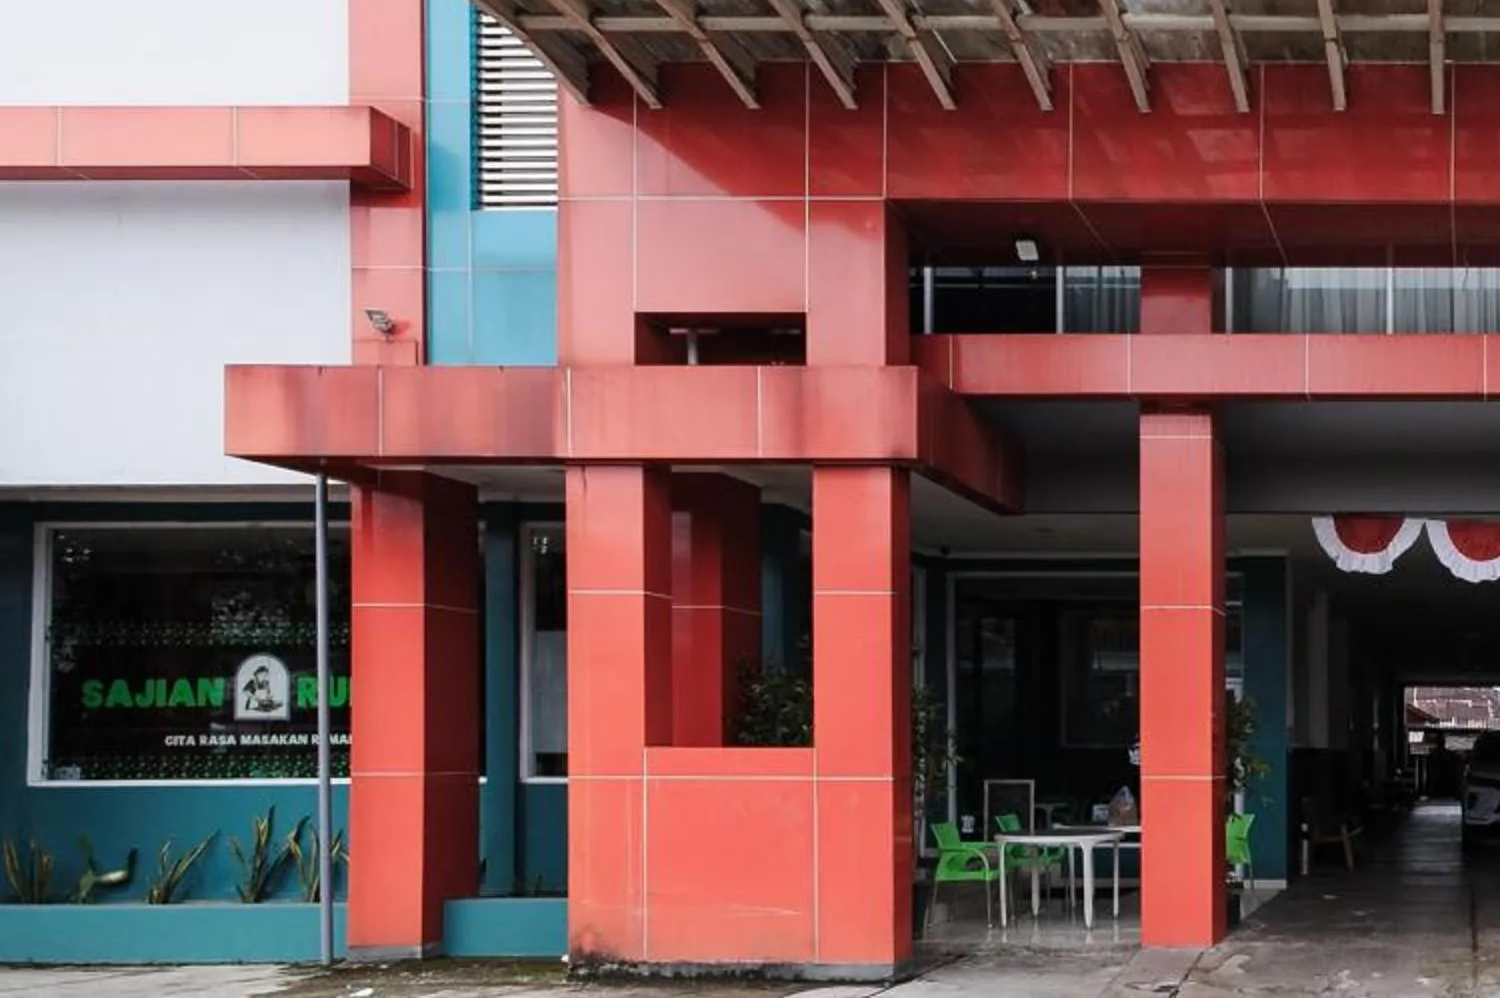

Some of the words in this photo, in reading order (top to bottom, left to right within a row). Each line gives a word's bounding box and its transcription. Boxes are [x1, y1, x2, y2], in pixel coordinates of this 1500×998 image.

[82, 678, 224, 708] SAJIAN
[297, 676, 352, 707] RU
[164, 735, 196, 746] CITA
[199, 734, 237, 746] RASA
[240, 733, 309, 745] MASAKAN
[311, 733, 353, 745] RMA
